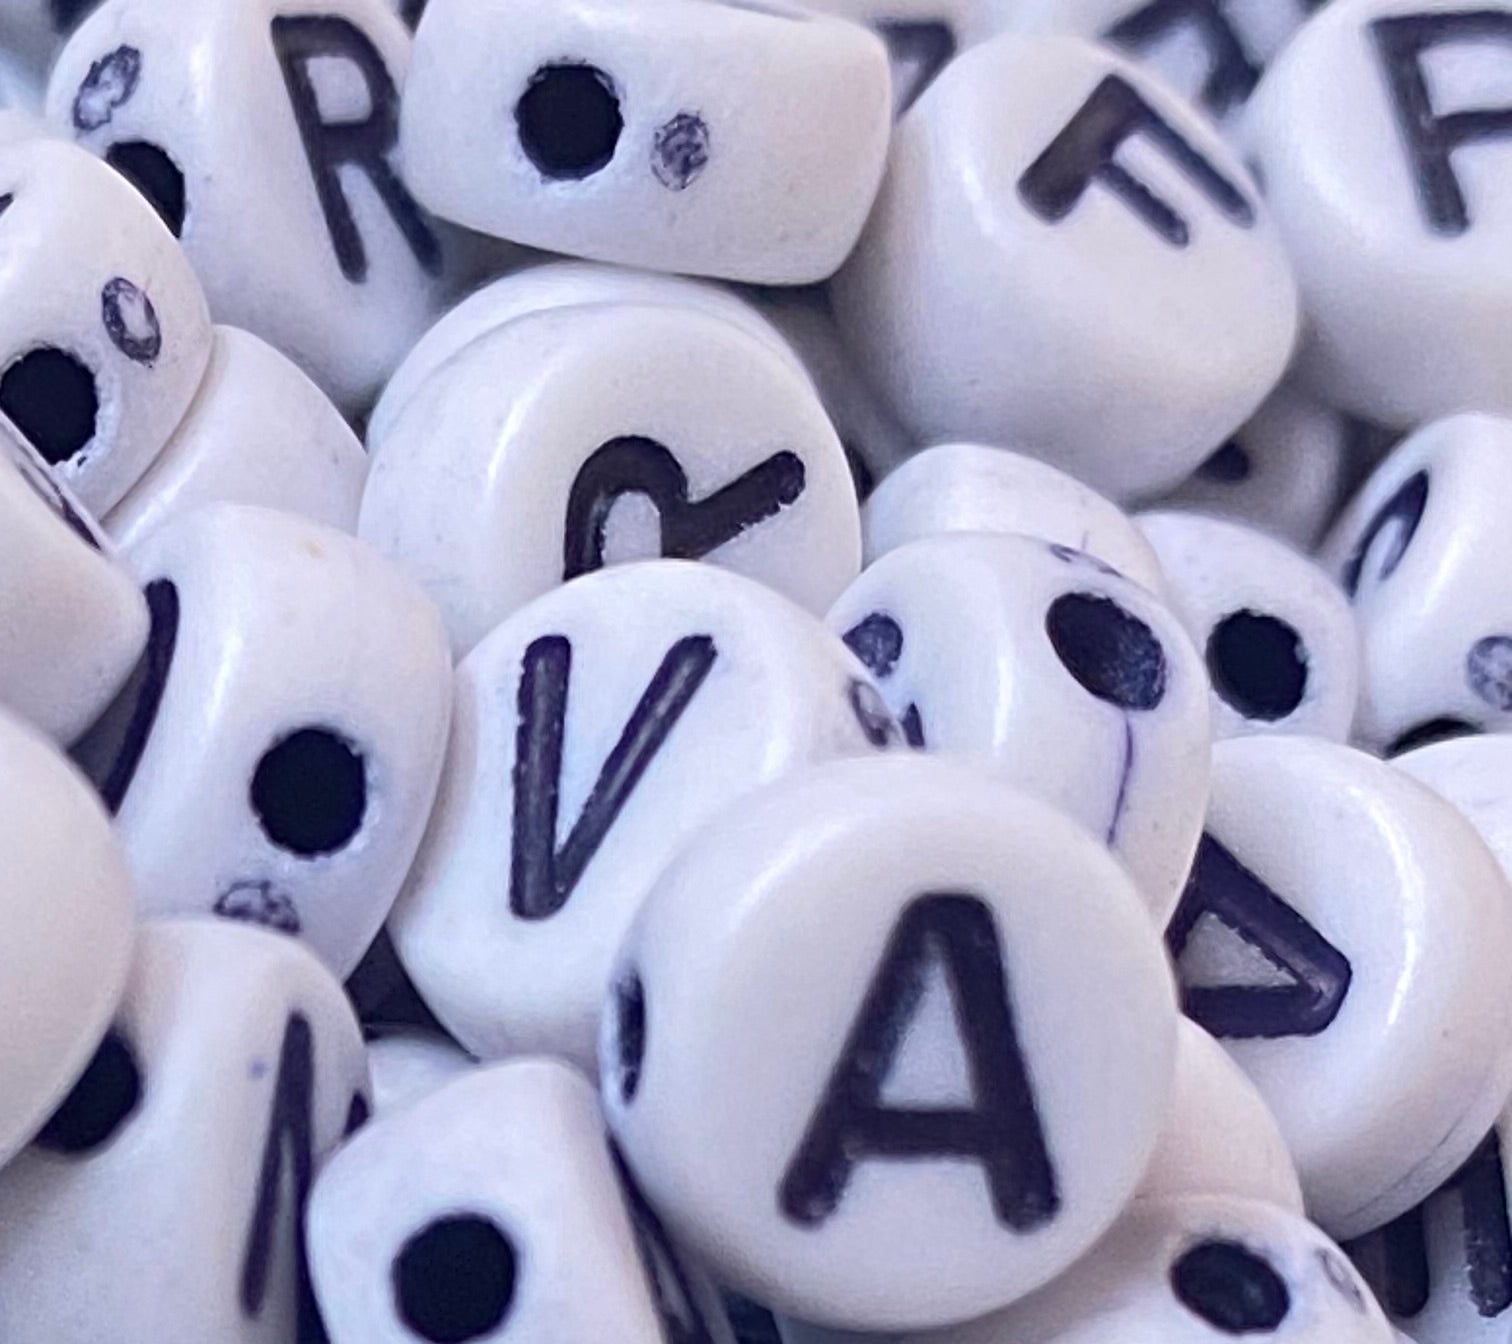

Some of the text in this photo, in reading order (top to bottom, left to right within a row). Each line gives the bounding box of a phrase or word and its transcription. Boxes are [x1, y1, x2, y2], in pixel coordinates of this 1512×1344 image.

[270, 14, 444, 283] R
[1016, 72, 1256, 250] F
[510, 632, 718, 922] V
[776, 888, 1063, 1234] A
